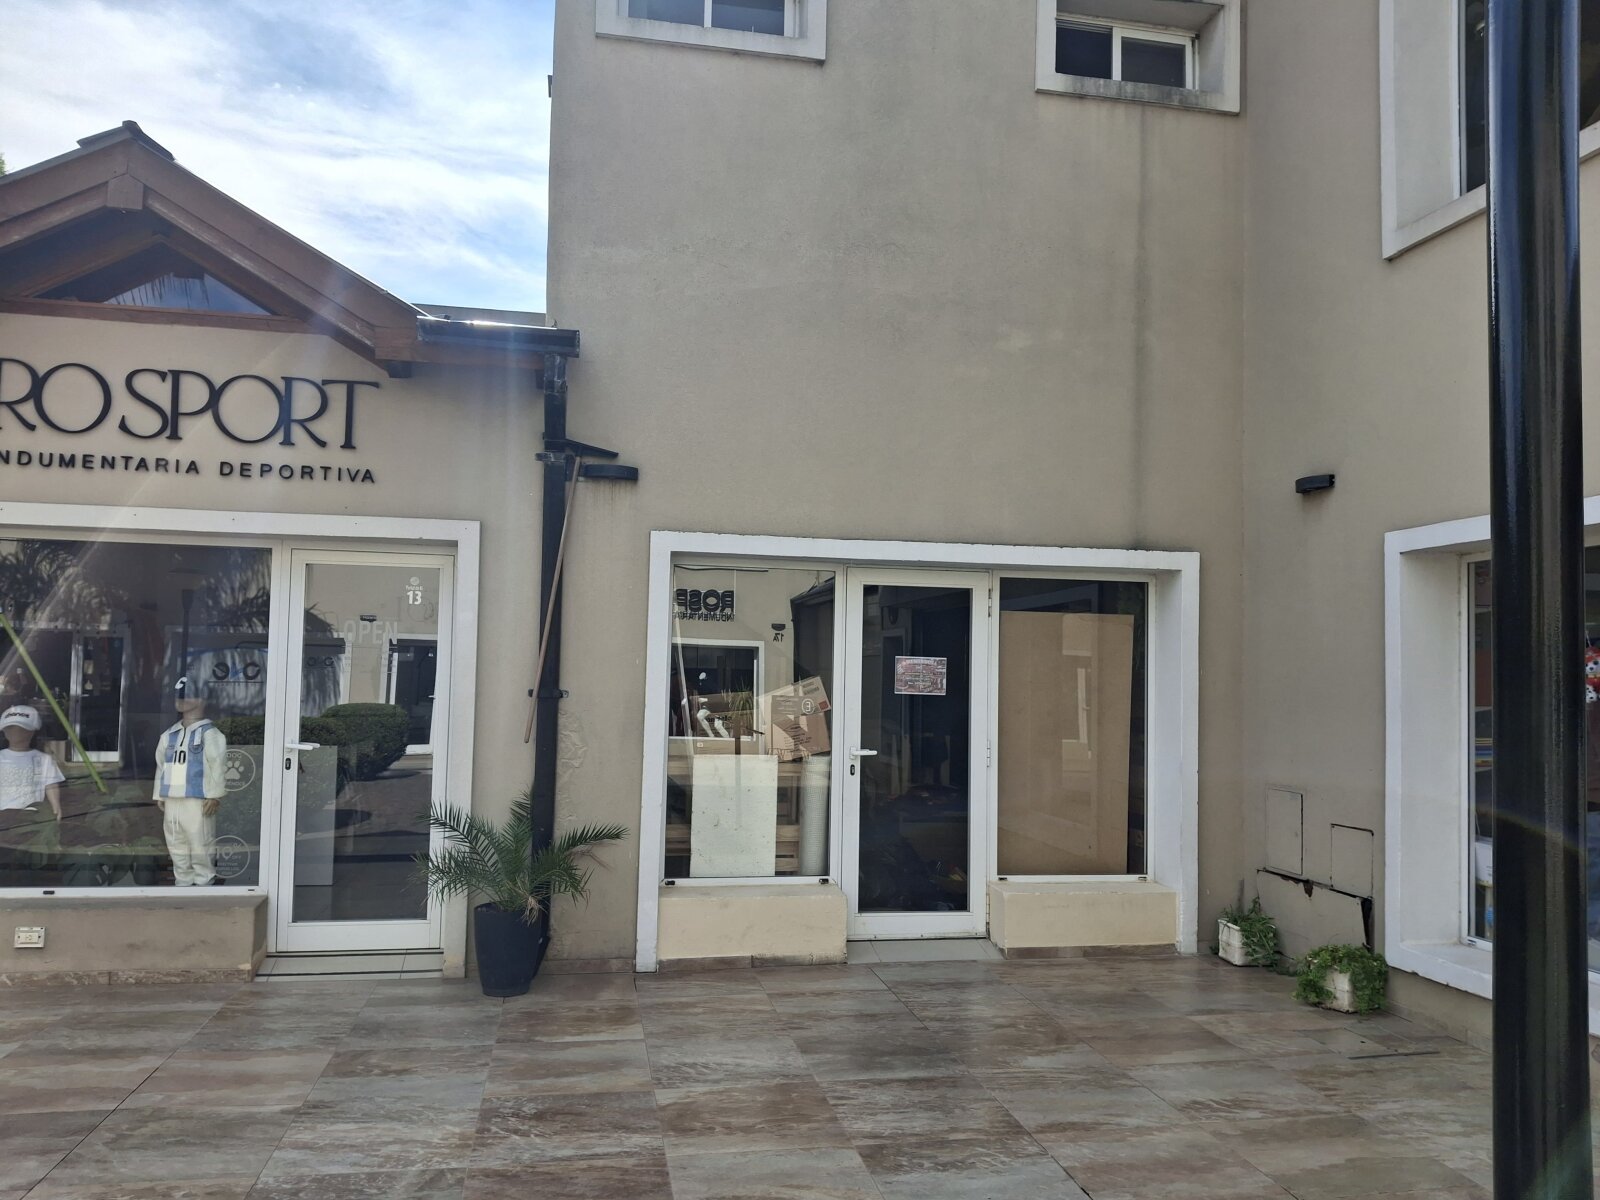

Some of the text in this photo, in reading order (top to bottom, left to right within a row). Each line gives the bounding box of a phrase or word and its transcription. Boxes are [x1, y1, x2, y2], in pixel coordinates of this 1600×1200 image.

[219, 461, 376, 484] DEPORTIVA
[406, 590, 422, 605] 13
[343, 620, 398, 645] OPEN
[173, 750, 187, 765] 10
